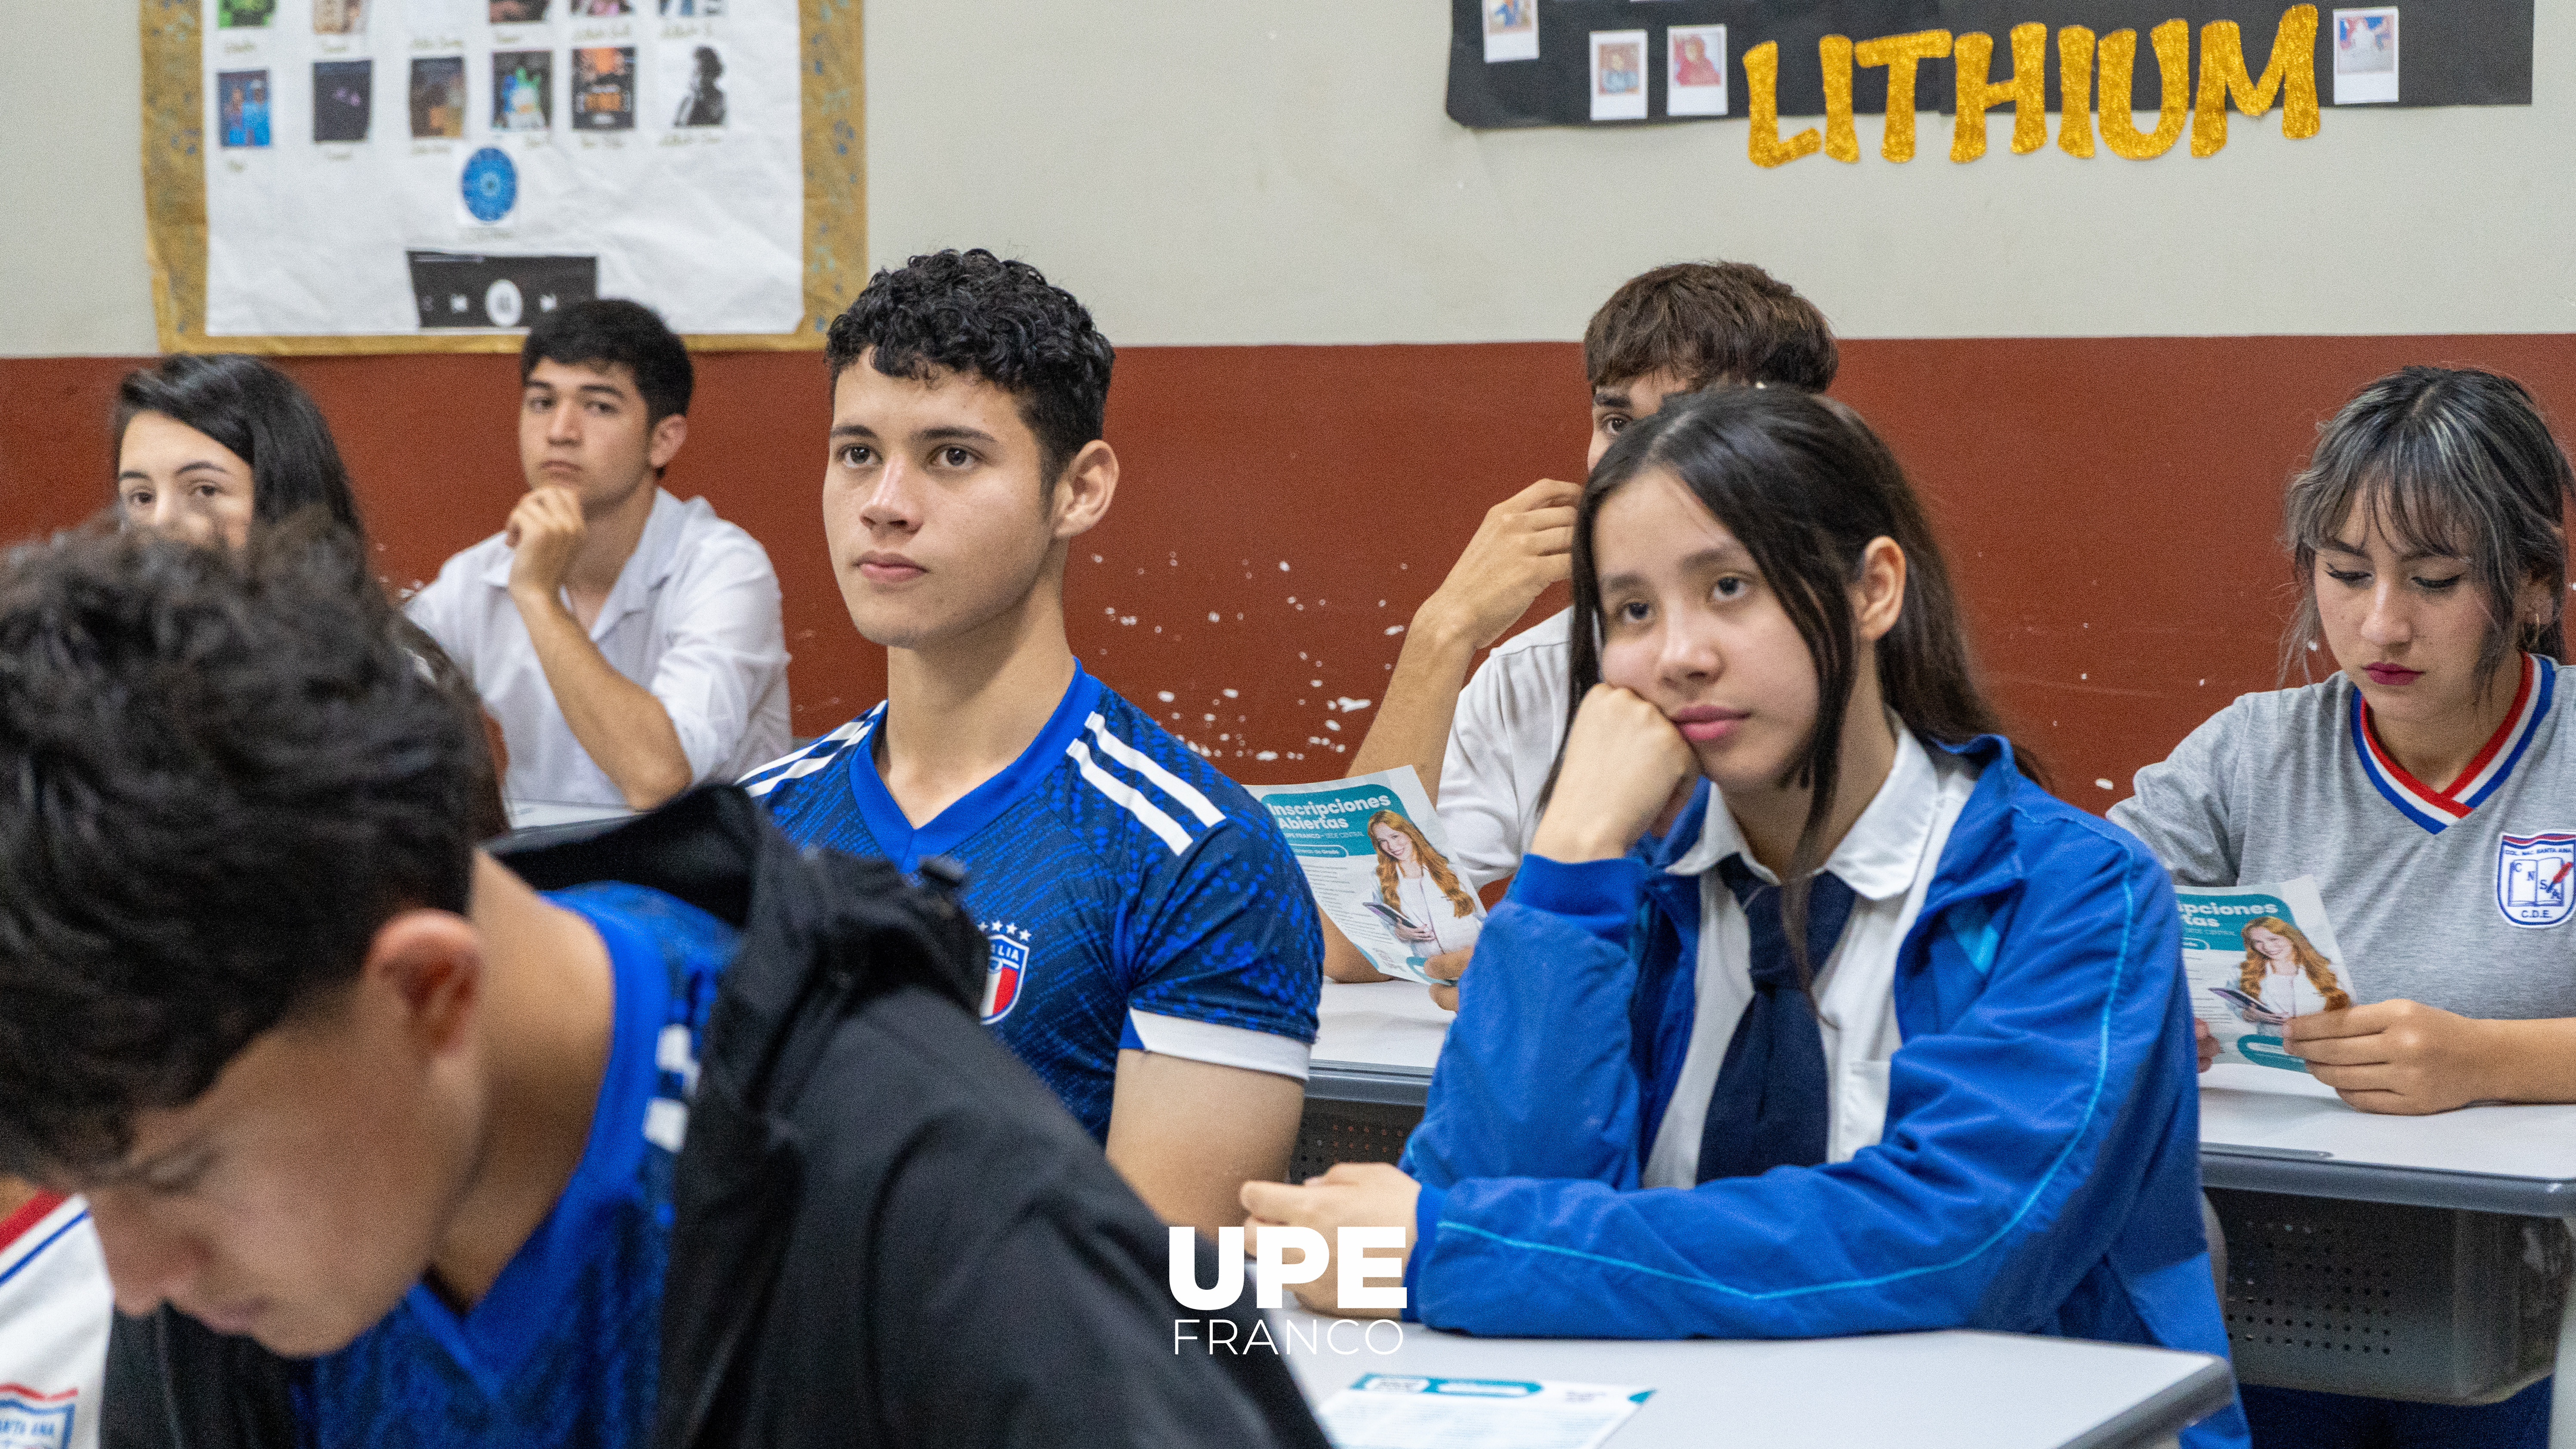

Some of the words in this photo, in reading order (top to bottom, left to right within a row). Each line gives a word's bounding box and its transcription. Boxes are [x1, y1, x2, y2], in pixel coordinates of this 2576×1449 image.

[1742, 3, 2320, 168] LITHIUM
[1267, 795, 1391, 819] Inscripciones
[1278, 816, 1349, 829] Abiertas
[2176, 902, 2278, 916] ipciones
